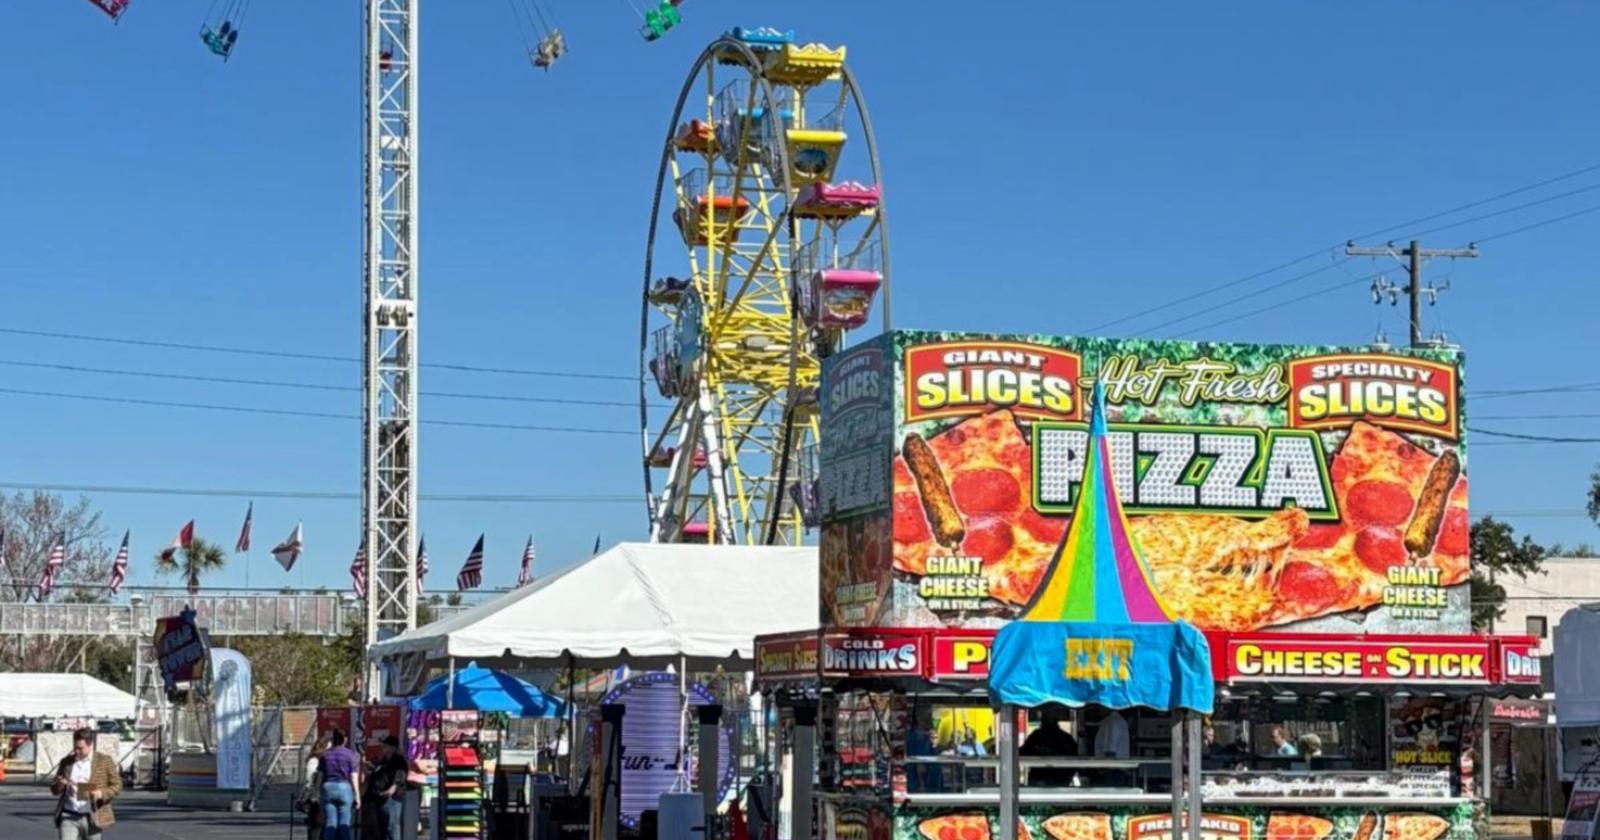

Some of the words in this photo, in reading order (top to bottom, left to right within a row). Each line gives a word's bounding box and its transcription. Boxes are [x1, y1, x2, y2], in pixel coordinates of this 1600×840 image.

[944, 350, 1047, 368] GIANT
[1082, 356, 1181, 402] Hot
[1177, 357, 1287, 404] Fresh
[1311, 363, 1432, 382] SPECIALTY
[831, 370, 879, 413] SLICES
[917, 368, 1073, 413] SLICES
[1299, 381, 1447, 424] SLICES
[1040, 429, 1327, 509] PIZZA
[926, 556, 983, 574] GIANT
[1387, 565, 1440, 585] GIANT
[920, 576, 988, 597] CHEESE
[1383, 587, 1447, 606] CHEESE
[843, 640, 884, 649] COLD
[824, 644, 916, 670] DRINKS
[1065, 638, 1133, 680] EXIT
[1236, 645, 1361, 675] CHEESE
[1386, 647, 1484, 677] STICK
[1396, 751, 1416, 764] HOT
[1200, 818, 1240, 833] AKED
